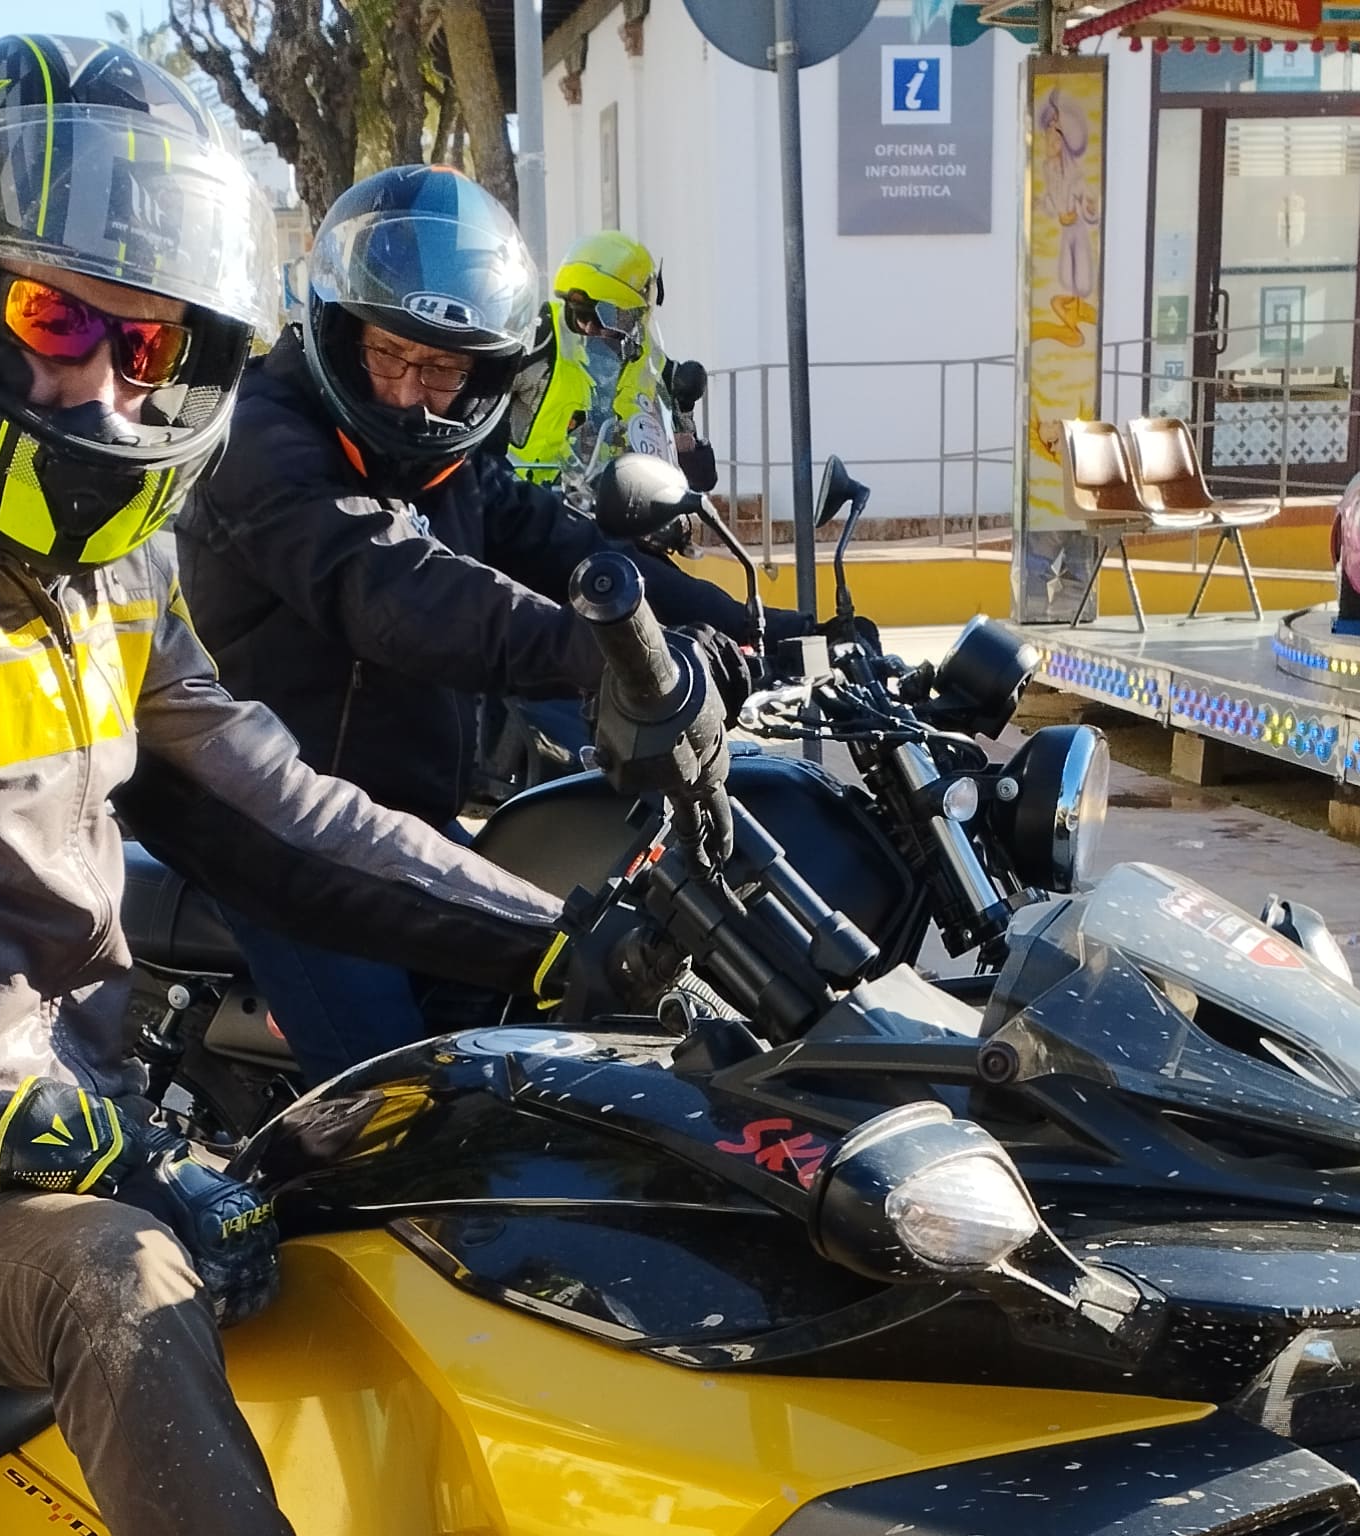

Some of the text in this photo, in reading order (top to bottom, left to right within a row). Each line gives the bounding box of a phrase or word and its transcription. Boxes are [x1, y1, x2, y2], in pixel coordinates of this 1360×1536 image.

[874, 143, 957, 156] OFICINA DE
[865, 162, 967, 177] INFORMACIÓN
[880, 183, 951, 198] TURÍSTICA
